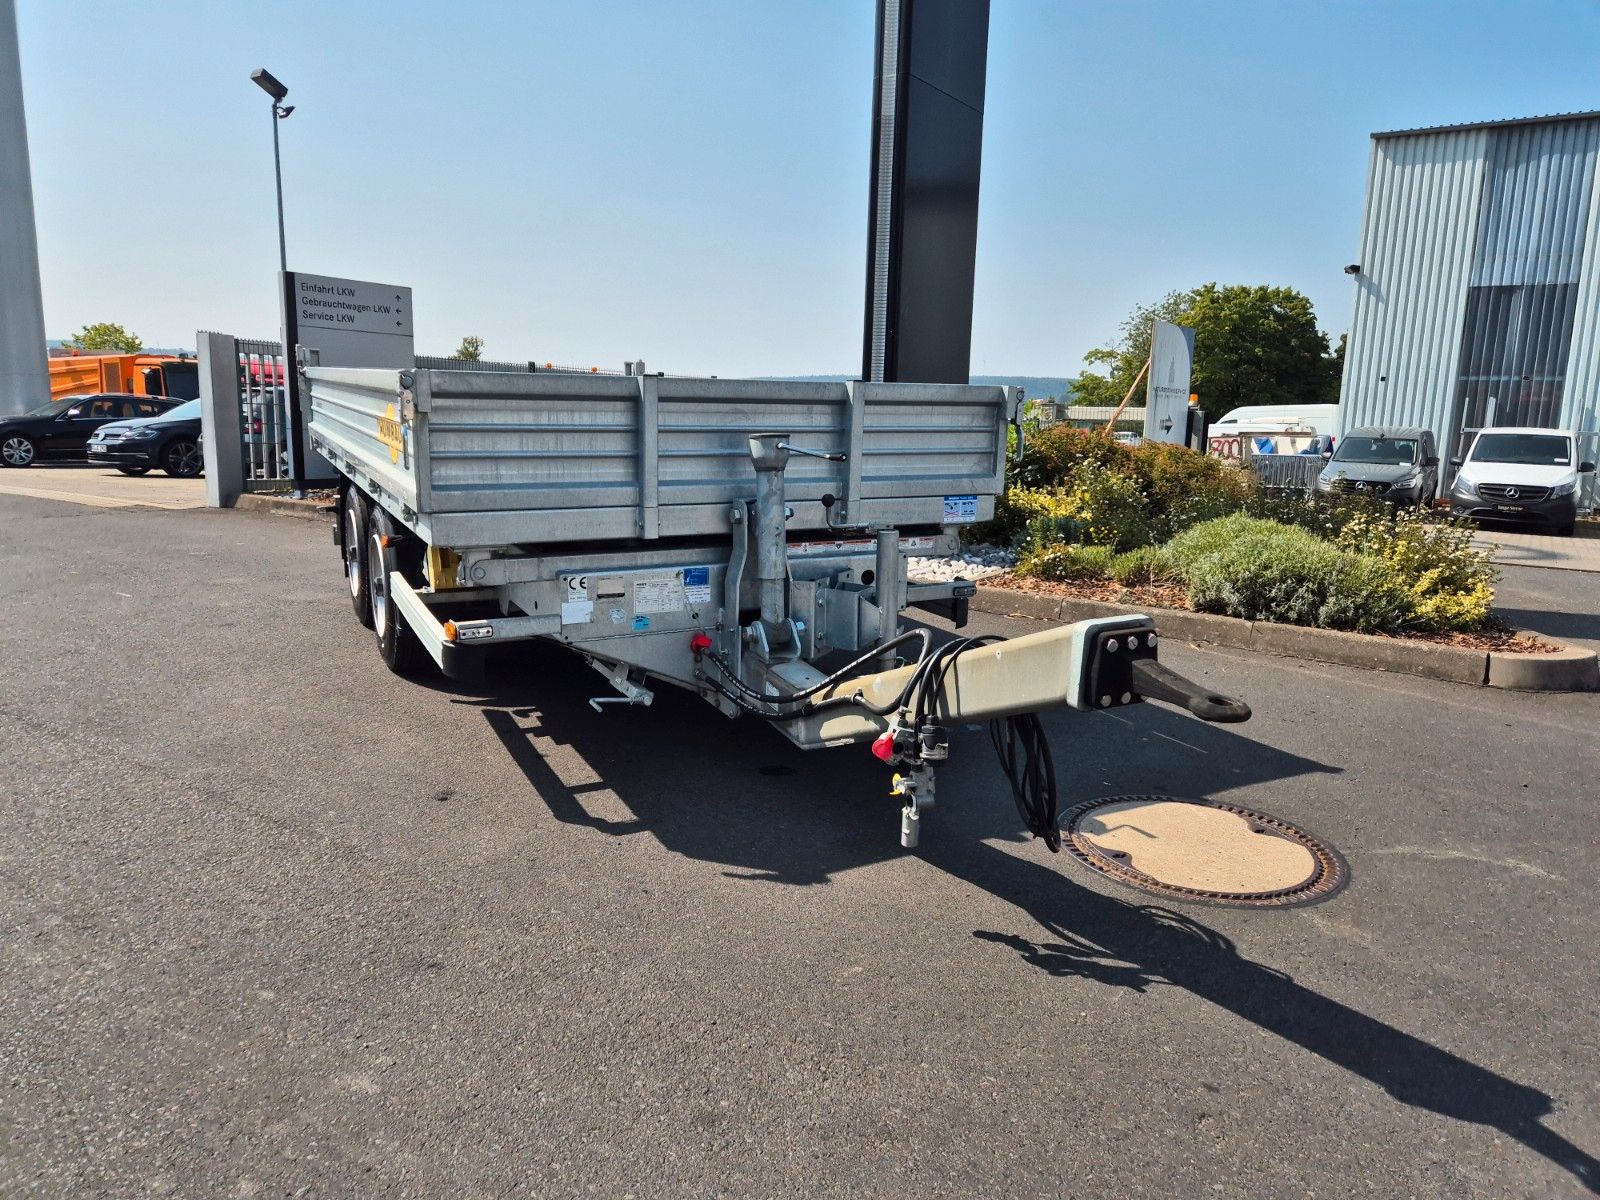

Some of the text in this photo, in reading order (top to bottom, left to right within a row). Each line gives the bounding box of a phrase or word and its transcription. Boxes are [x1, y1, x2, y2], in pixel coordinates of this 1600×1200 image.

[301, 282, 355, 297] Einfahrt LKW
[302, 296, 391, 314] Gebrauchtwagen LKW
[302, 310, 355, 323] Service LKW
